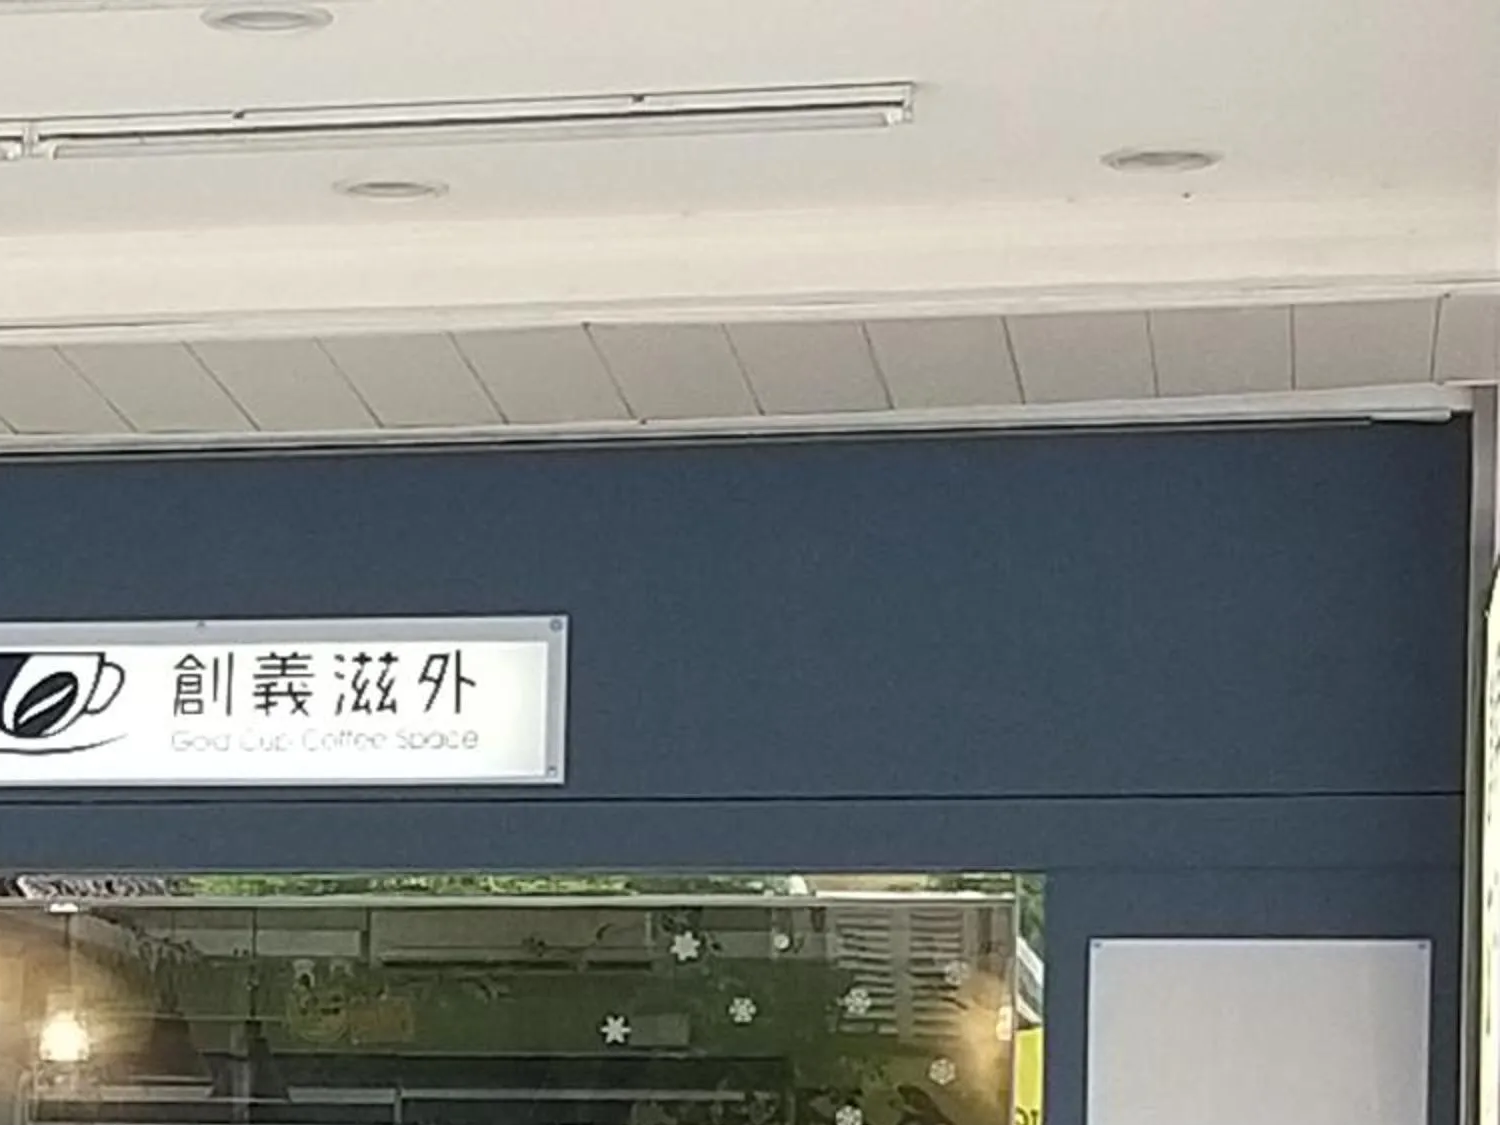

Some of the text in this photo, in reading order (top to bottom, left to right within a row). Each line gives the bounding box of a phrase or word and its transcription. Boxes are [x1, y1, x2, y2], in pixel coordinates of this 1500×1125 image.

[171, 647, 478, 717] 創義滋外
[302, 728, 389, 752] Coffee
[396, 728, 480, 755] Space
